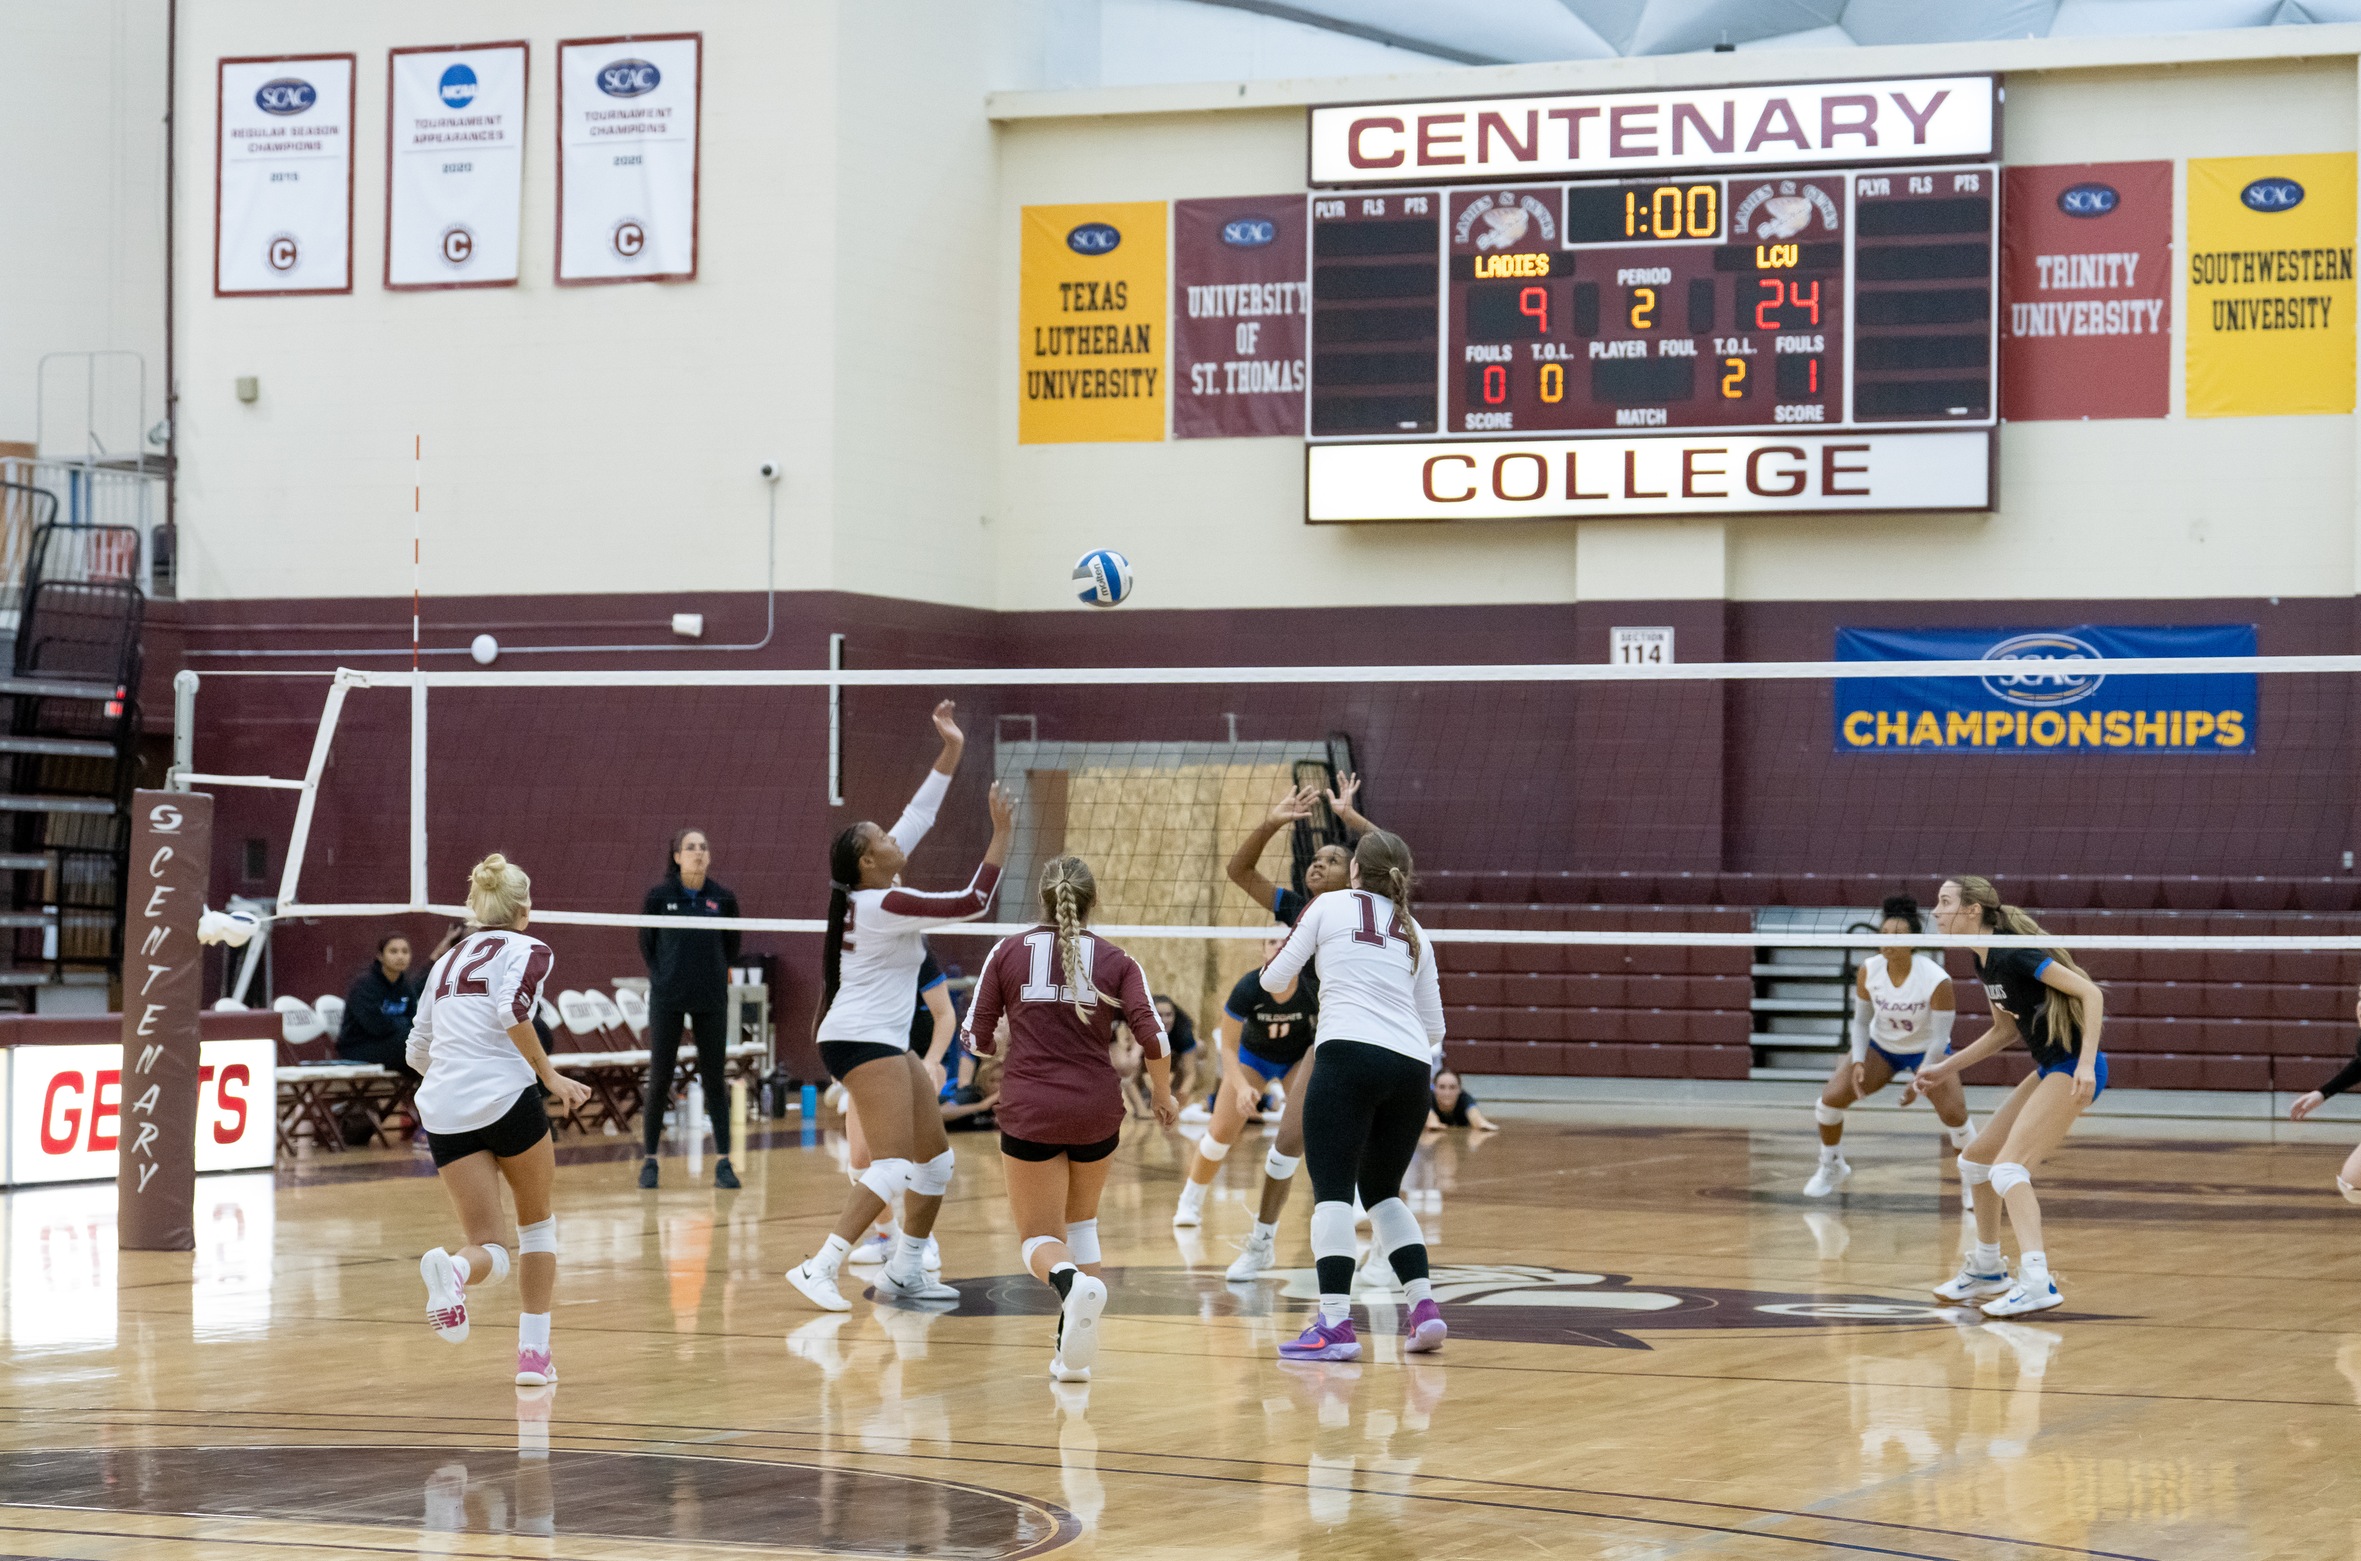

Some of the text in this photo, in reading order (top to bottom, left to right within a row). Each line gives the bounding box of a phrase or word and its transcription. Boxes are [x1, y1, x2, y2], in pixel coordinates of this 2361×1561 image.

[604, 68, 655, 89] SCAC
[261, 86, 312, 107] SCAC
[414, 115, 503, 129] TOURNAMENT
[585, 107, 673, 121] TOURNAMENT
[231, 125, 339, 139] REGULAR SEASON
[412, 130, 504, 145] APPEARANCES
[590, 123, 668, 136] CHAMPIONS
[1347, 90, 1954, 170] CENTENARY
[248, 141, 322, 153] CHAMPIONS
[1858, 174, 1980, 197] PLYR FLS PTS
[2063, 190, 2112, 210] SCAC
[2249, 184, 2297, 206] SCAC
[1315, 197, 1428, 218] PLYR FLS PTS
[1625, 185, 1716, 239] 1:00
[1072, 229, 1117, 249] SCAC
[1223, 221, 1273, 246] SCAC
[1475, 253, 1550, 279] LADIES
[1756, 243, 1798, 270] LCU
[2036, 252, 2140, 290] TRINITY
[2192, 248, 2353, 286] SOUTHWESTERN
[1617, 267, 1672, 286] PERIOD
[1060, 280, 1128, 312] TEXAS
[1187, 282, 1307, 318] UNIVERSITY
[1519, 286, 1548, 333] 9
[1631, 288, 1655, 329] 2
[1755, 278, 1819, 330] 24
[2011, 299, 2163, 337] UNIVERSITY
[2212, 296, 2332, 332] UNIVERSITY
[1034, 324, 1152, 357] LUTHERAN
[1236, 322, 1261, 355] OF
[1465, 344, 1513, 362] FOULS
[1530, 343, 1574, 361] T.O.L.
[1589, 339, 1698, 360] PLAYER FOUL
[1713, 337, 1758, 355] T.O.L.
[1775, 335, 1825, 354] FOULS
[1027, 367, 1158, 400] UNIVERSITY
[1191, 360, 1306, 395] ST. THOMAS
[1483, 365, 1506, 404] 0
[1540, 363, 1564, 403] 0
[1722, 358, 1746, 399] 2
[1809, 359, 1817, 393] 1
[1465, 411, 1513, 430] SCORE
[1616, 408, 1667, 427] MATCH
[1774, 404, 1825, 423] SCORE
[1421, 443, 1872, 503] COLLEGE
[1093, 563, 1109, 597] molten
[1621, 645, 1661, 665] 114
[1843, 709, 2246, 748] CHAMPIONSHIPS
[434, 935, 509, 1004] 12
[1020, 932, 1098, 1007] 11
[130, 845, 176, 1193] CENTENARY
[40, 1063, 250, 1155] GETS
